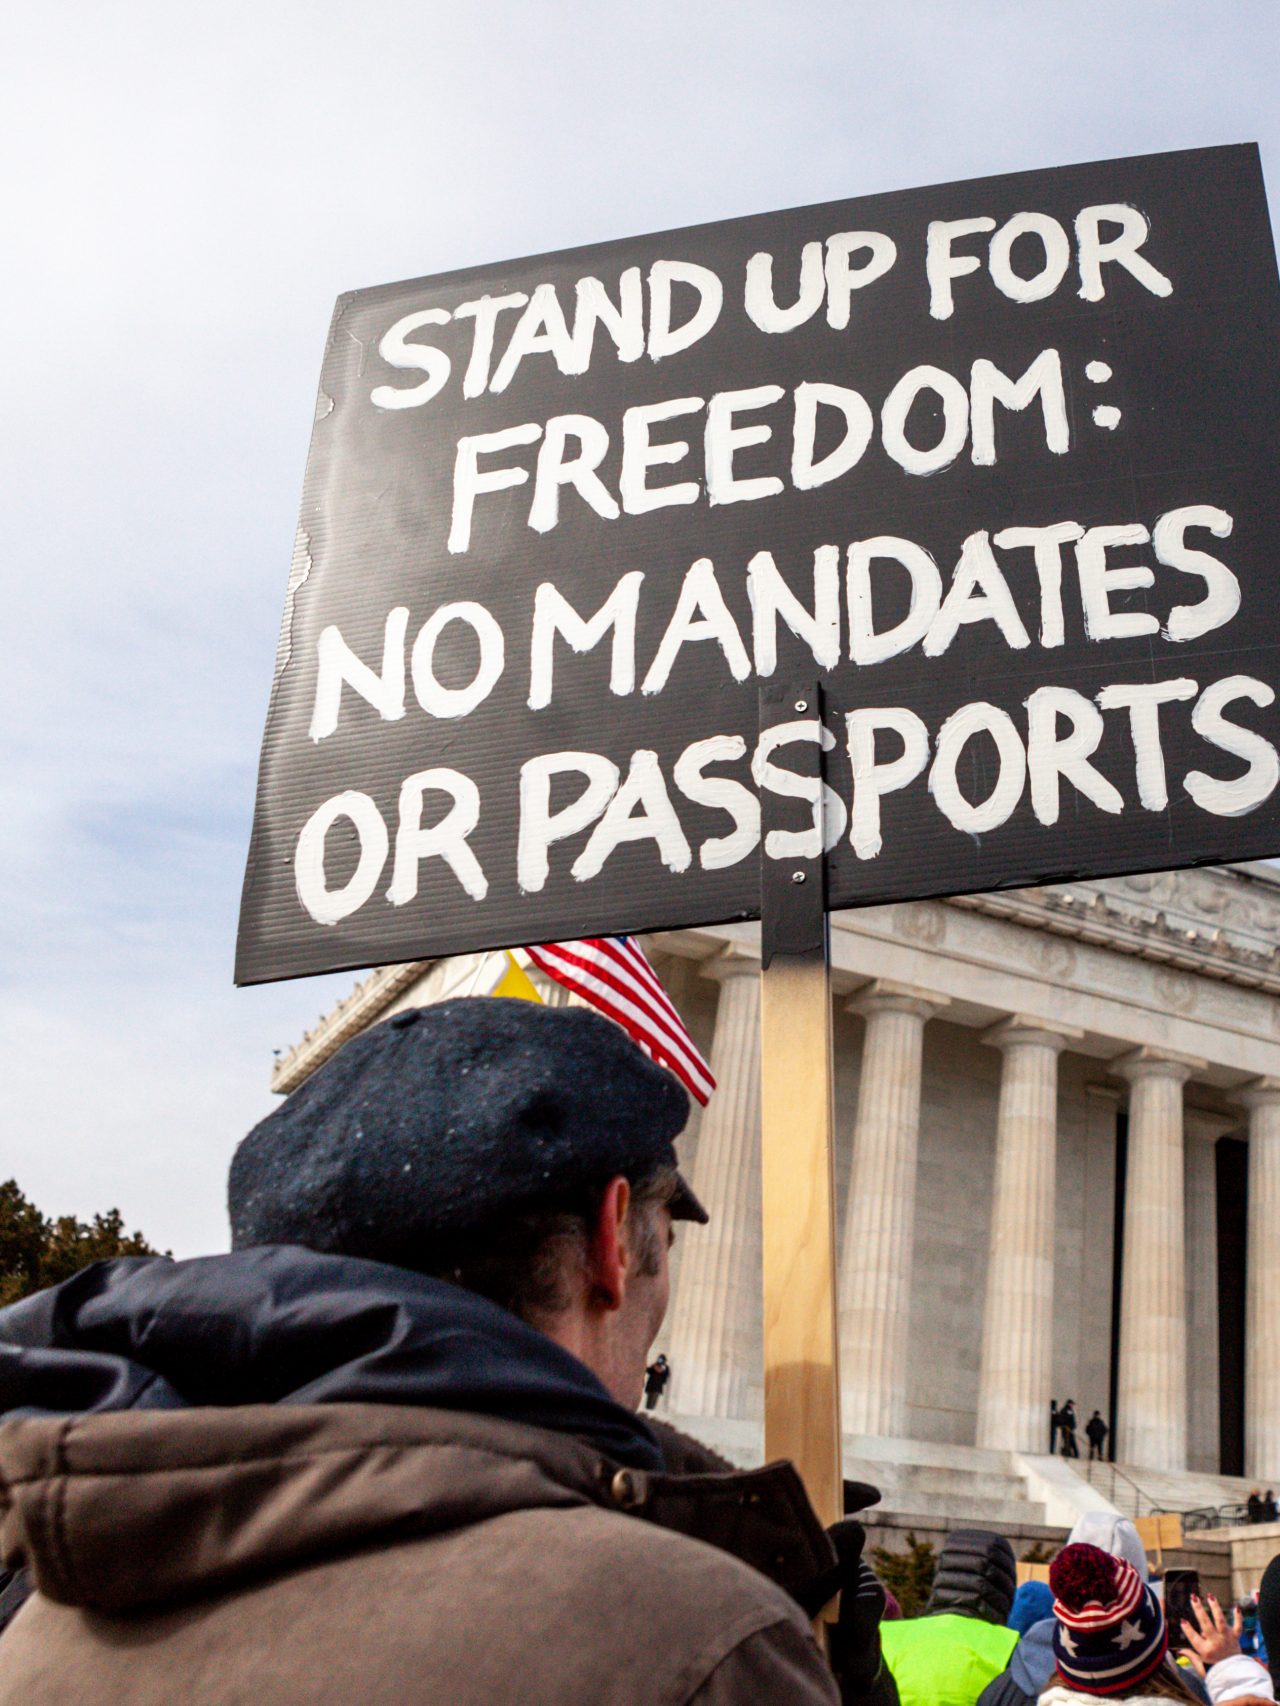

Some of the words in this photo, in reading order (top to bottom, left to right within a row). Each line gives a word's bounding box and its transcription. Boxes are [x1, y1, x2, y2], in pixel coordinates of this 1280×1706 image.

[370, 259, 724, 410] STAND
[744, 230, 898, 331] UP
[925, 202, 1174, 321] FOR
[446, 348, 1122, 556] FREEDOM:
[308, 600, 505, 744] NO
[526, 504, 1242, 712] MANDATES
[293, 767, 489, 927] OR
[516, 674, 1280, 895] PASSPORTS
